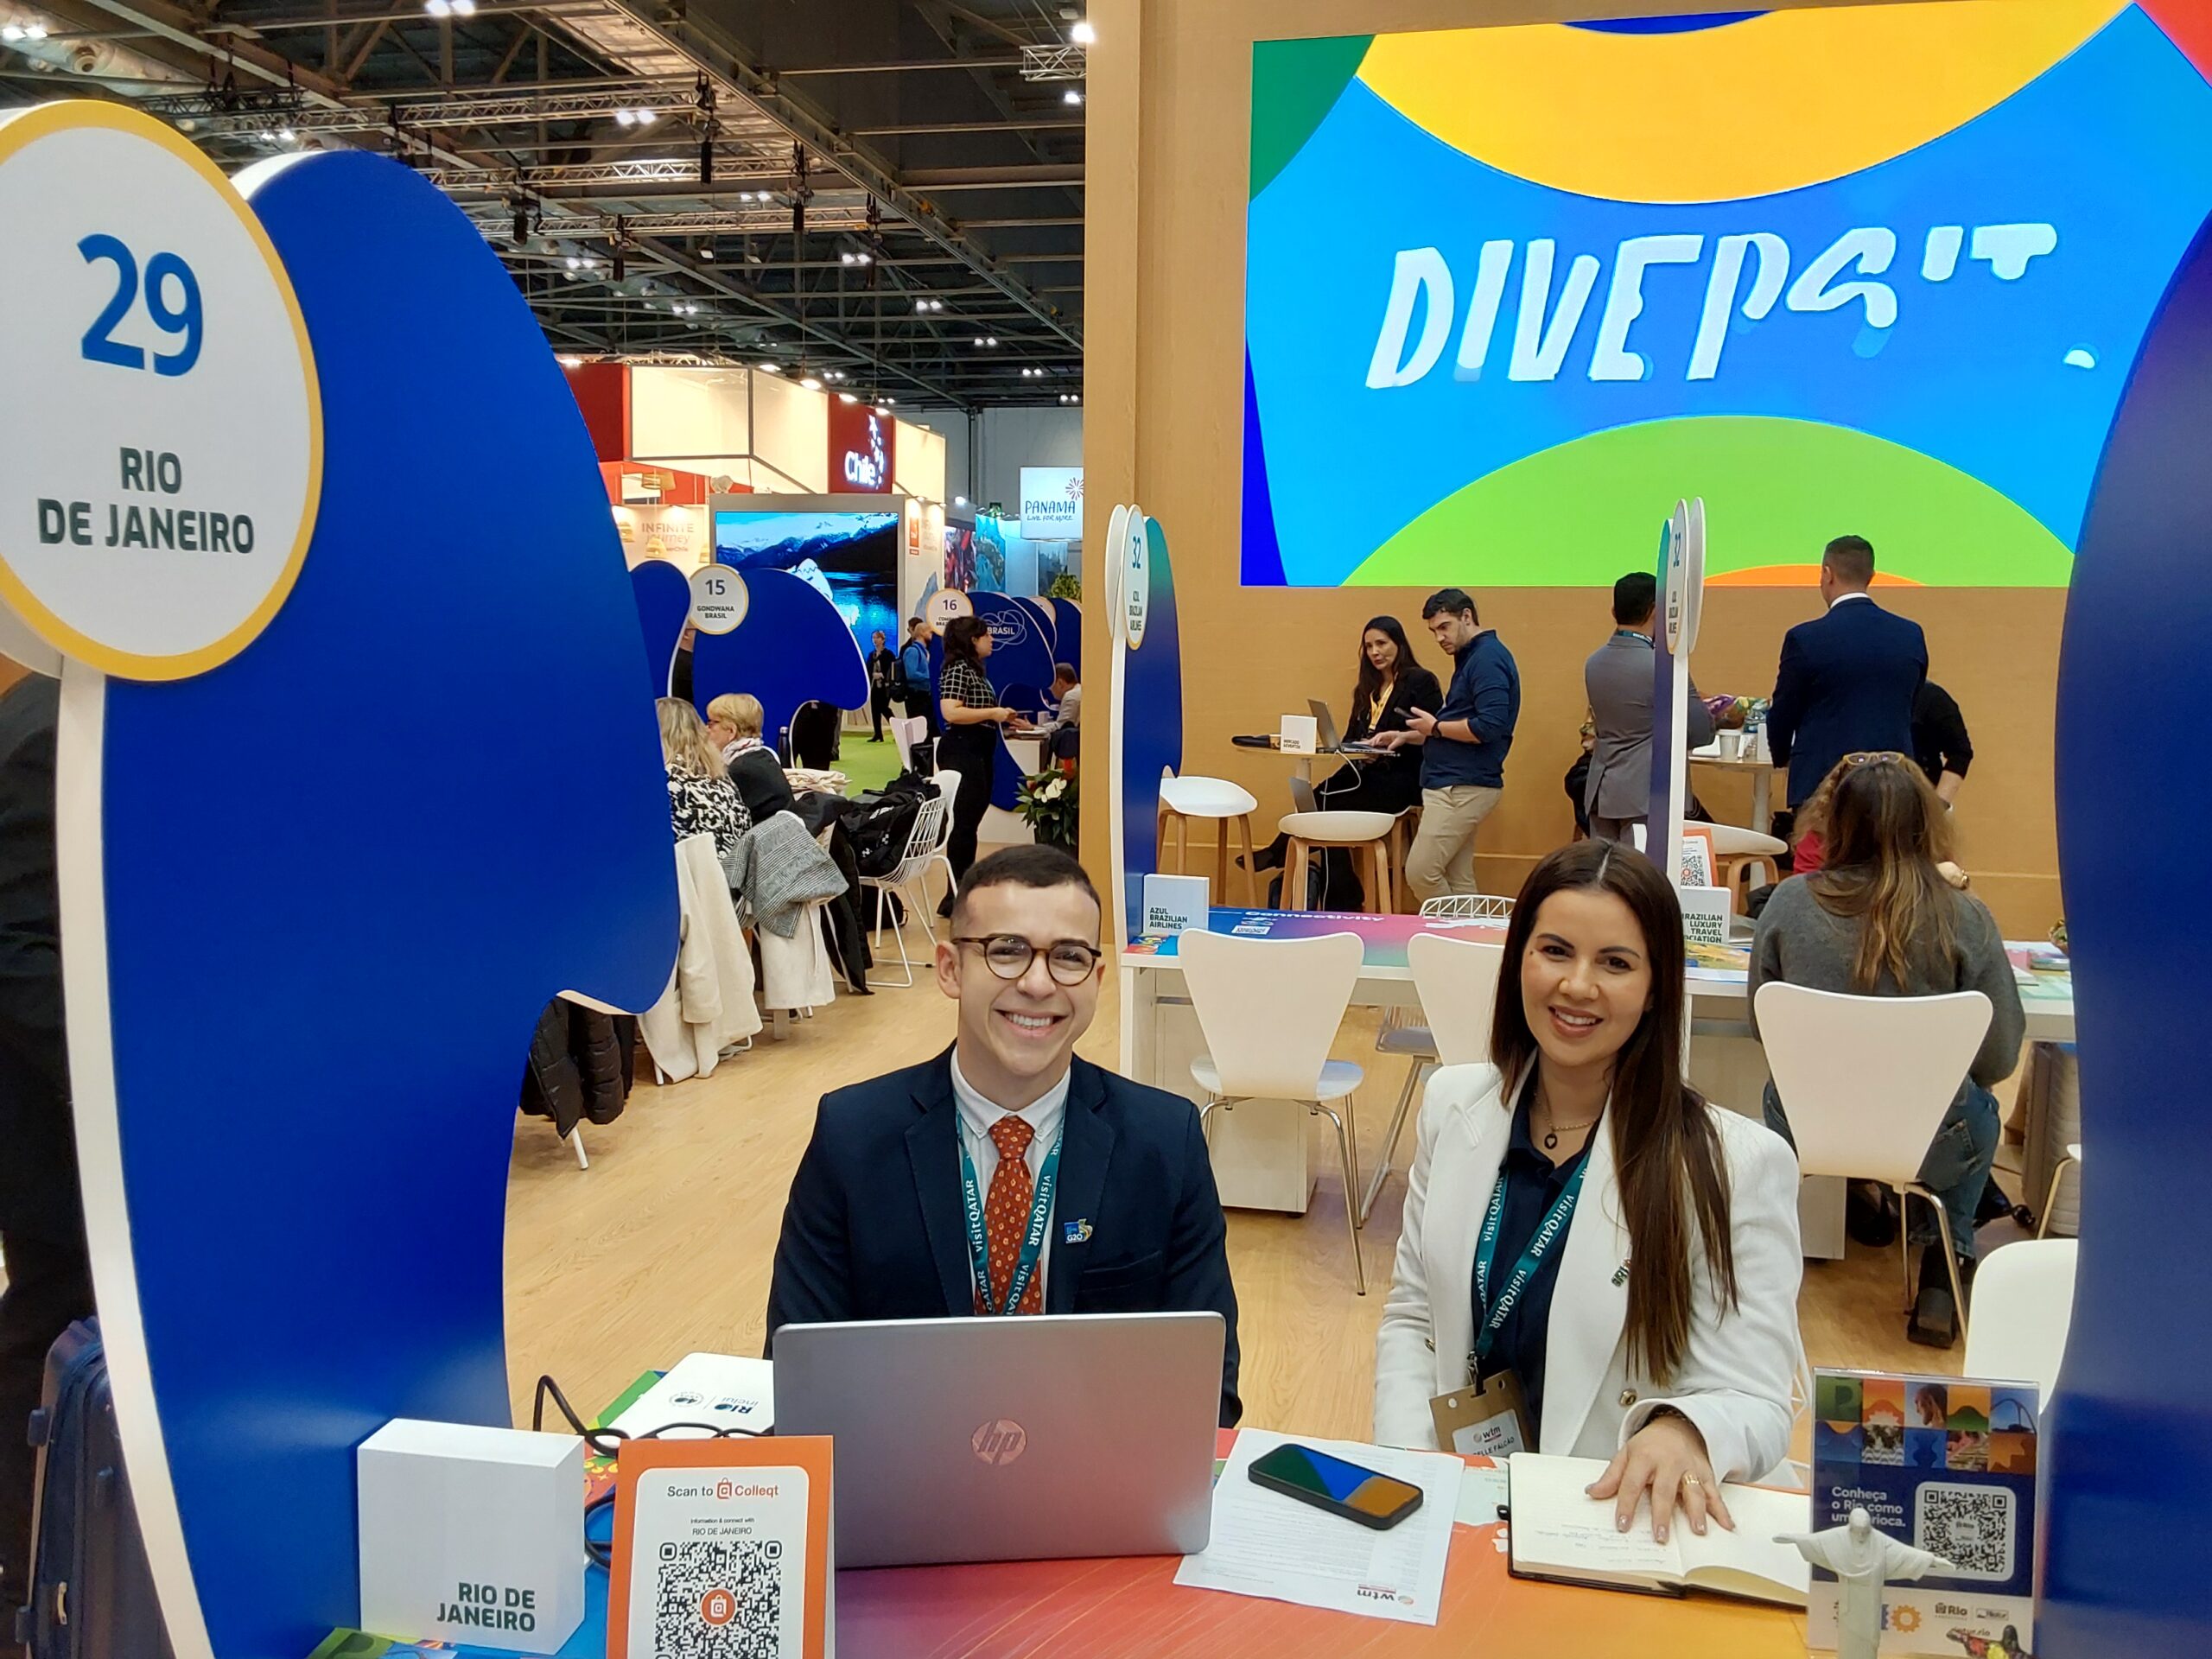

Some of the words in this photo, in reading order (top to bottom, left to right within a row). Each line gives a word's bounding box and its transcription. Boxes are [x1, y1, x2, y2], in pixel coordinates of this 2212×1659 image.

[76, 232, 203, 377] 29
[119, 446, 181, 495] RIO
[844, 450, 876, 486] Chile
[1025, 500, 1076, 514] PANAMA
[37, 498, 92, 545] DE
[105, 503, 255, 554] JANEIRO
[642, 523, 695, 533] INFINITE
[1132, 535, 1141, 569] 32
[705, 579, 726, 595] 15
[943, 599, 957, 611] 16
[987, 626, 1015, 635] BRASIL
[1150, 914, 1187, 923] BRAZILIAN
[1245, 911, 1385, 921] Connectivity
[1149, 921, 1182, 930] AIRLINES
[965, 1179, 983, 1253] visitQATAR
[1028, 1175, 1051, 1246] visitQATAR
[1530, 1194, 1574, 1257] visitQATAR
[1489, 1269, 1527, 1329] visitQATAR
[1483, 1427, 1501, 1439] wtm
[667, 1485, 698, 1497] Scan
[702, 1485, 714, 1497] to
[734, 1484, 779, 1498] Colleqt
[1832, 1486, 1887, 1502] Conheça
[1832, 1501, 1840, 1510] o
[1867, 1503, 1904, 1514] como
[458, 1582, 497, 1605] RIO
[505, 1587, 536, 1609] DE
[1357, 1589, 1395, 1601] wtm
[436, 1603, 536, 1632] JANEIRO
[1948, 1605, 1967, 1616] Rio
